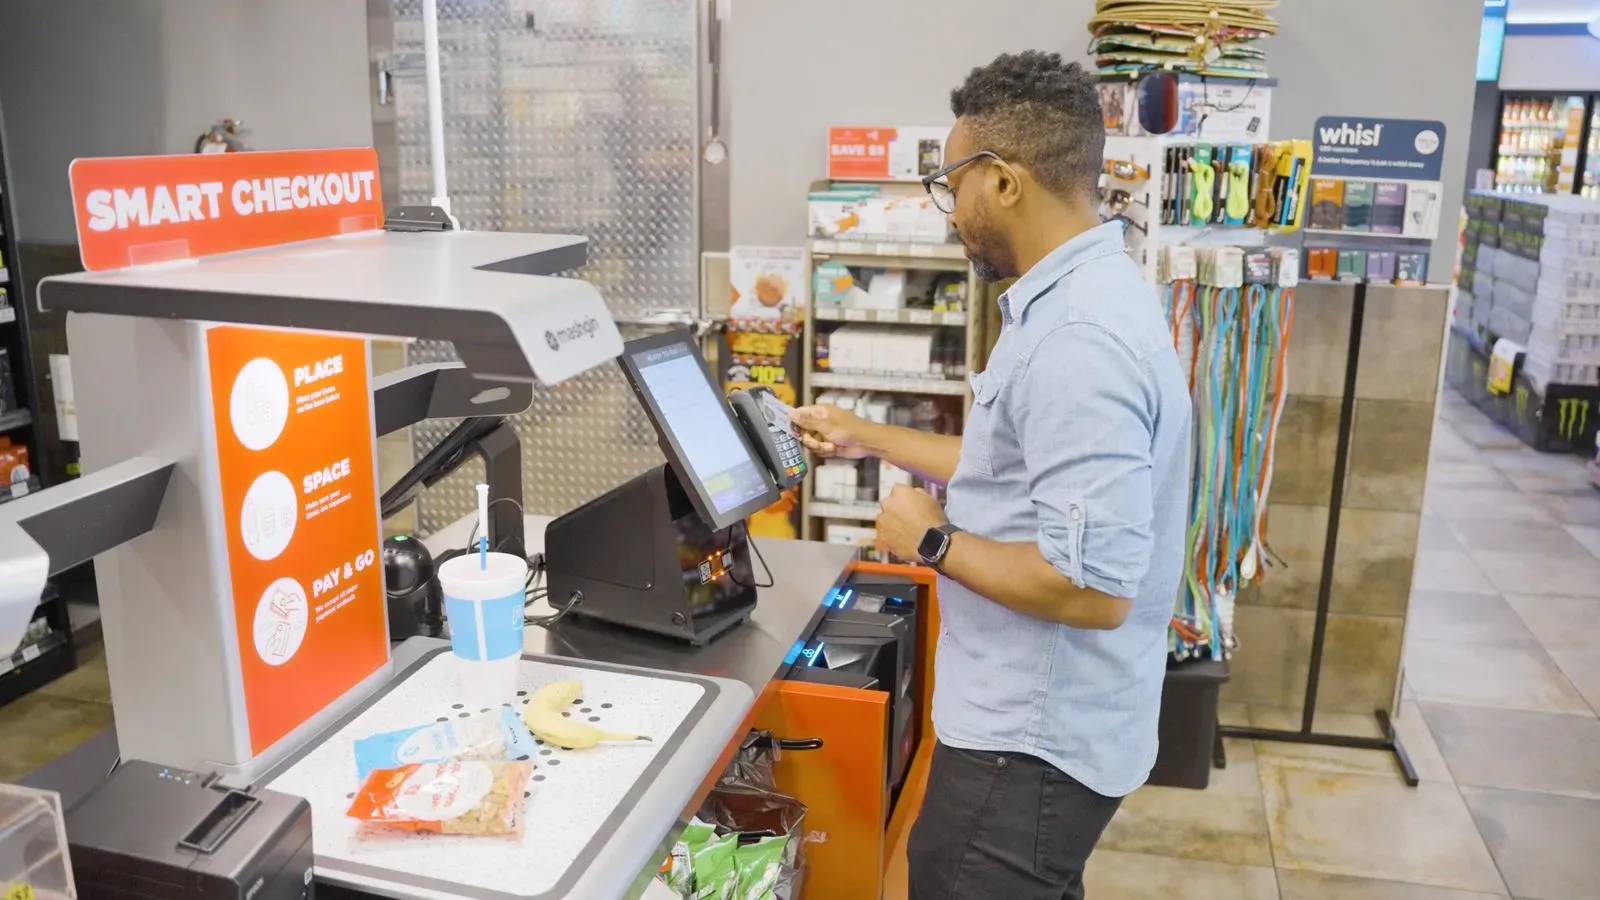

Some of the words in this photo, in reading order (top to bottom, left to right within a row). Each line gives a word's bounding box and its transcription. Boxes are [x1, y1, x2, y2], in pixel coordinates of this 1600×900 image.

[831, 144, 865, 156] SAVE
[1320, 122, 1381, 147] whisl
[1341, 157, 1370, 167] frequency
[86, 181, 223, 232] SMART
[232, 170, 375, 216] CHECKOUT
[556, 314, 600, 342] mashgin
[294, 354, 344, 388] PLACE
[303, 458, 350, 494] SPACE
[312, 568, 340, 598] PAY
[343, 561, 353, 580] &
[355, 548, 375, 572] GO
